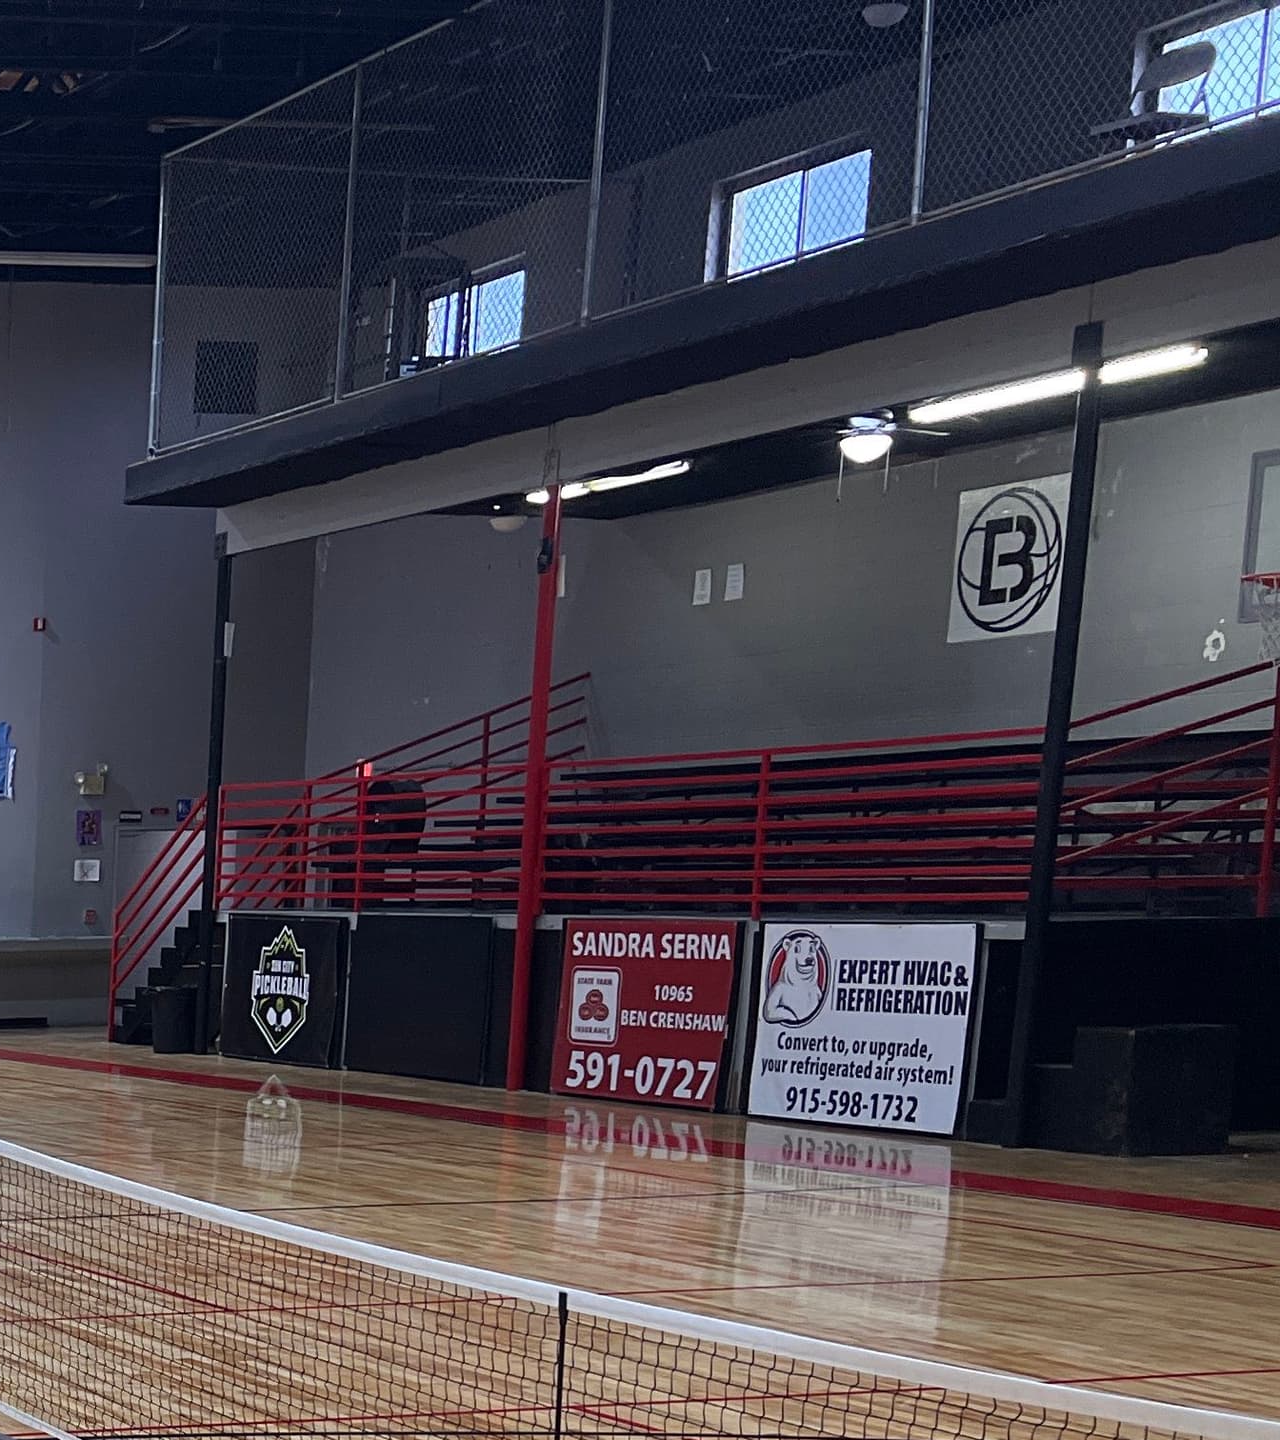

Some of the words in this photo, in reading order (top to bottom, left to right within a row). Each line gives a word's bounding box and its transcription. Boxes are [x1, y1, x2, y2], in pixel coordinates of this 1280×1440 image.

[572, 931, 655, 958] SANDRA
[660, 933, 732, 961] SERNA
[839, 959, 900, 985] EXPERT
[254, 975, 310, 1001] PICKLEBALL
[654, 985, 693, 1002] 10965
[836, 988, 969, 1016] REFRIGERATION
[621, 1009, 647, 1027] BEN
[649, 1011, 726, 1032] CRENSHAW
[777, 1032, 828, 1052] Convert
[832, 1036, 849, 1056] to,
[852, 1040, 867, 1053] or
[870, 1038, 933, 1062] upgrade,
[565, 1050, 716, 1100] 591-0727
[761, 1057, 788, 1076] your
[790, 1056, 872, 1080] refrigerated
[875, 1061, 895, 1080] air
[897, 1065, 954, 1087] system!
[786, 1087, 918, 1122] 915-598-1732
